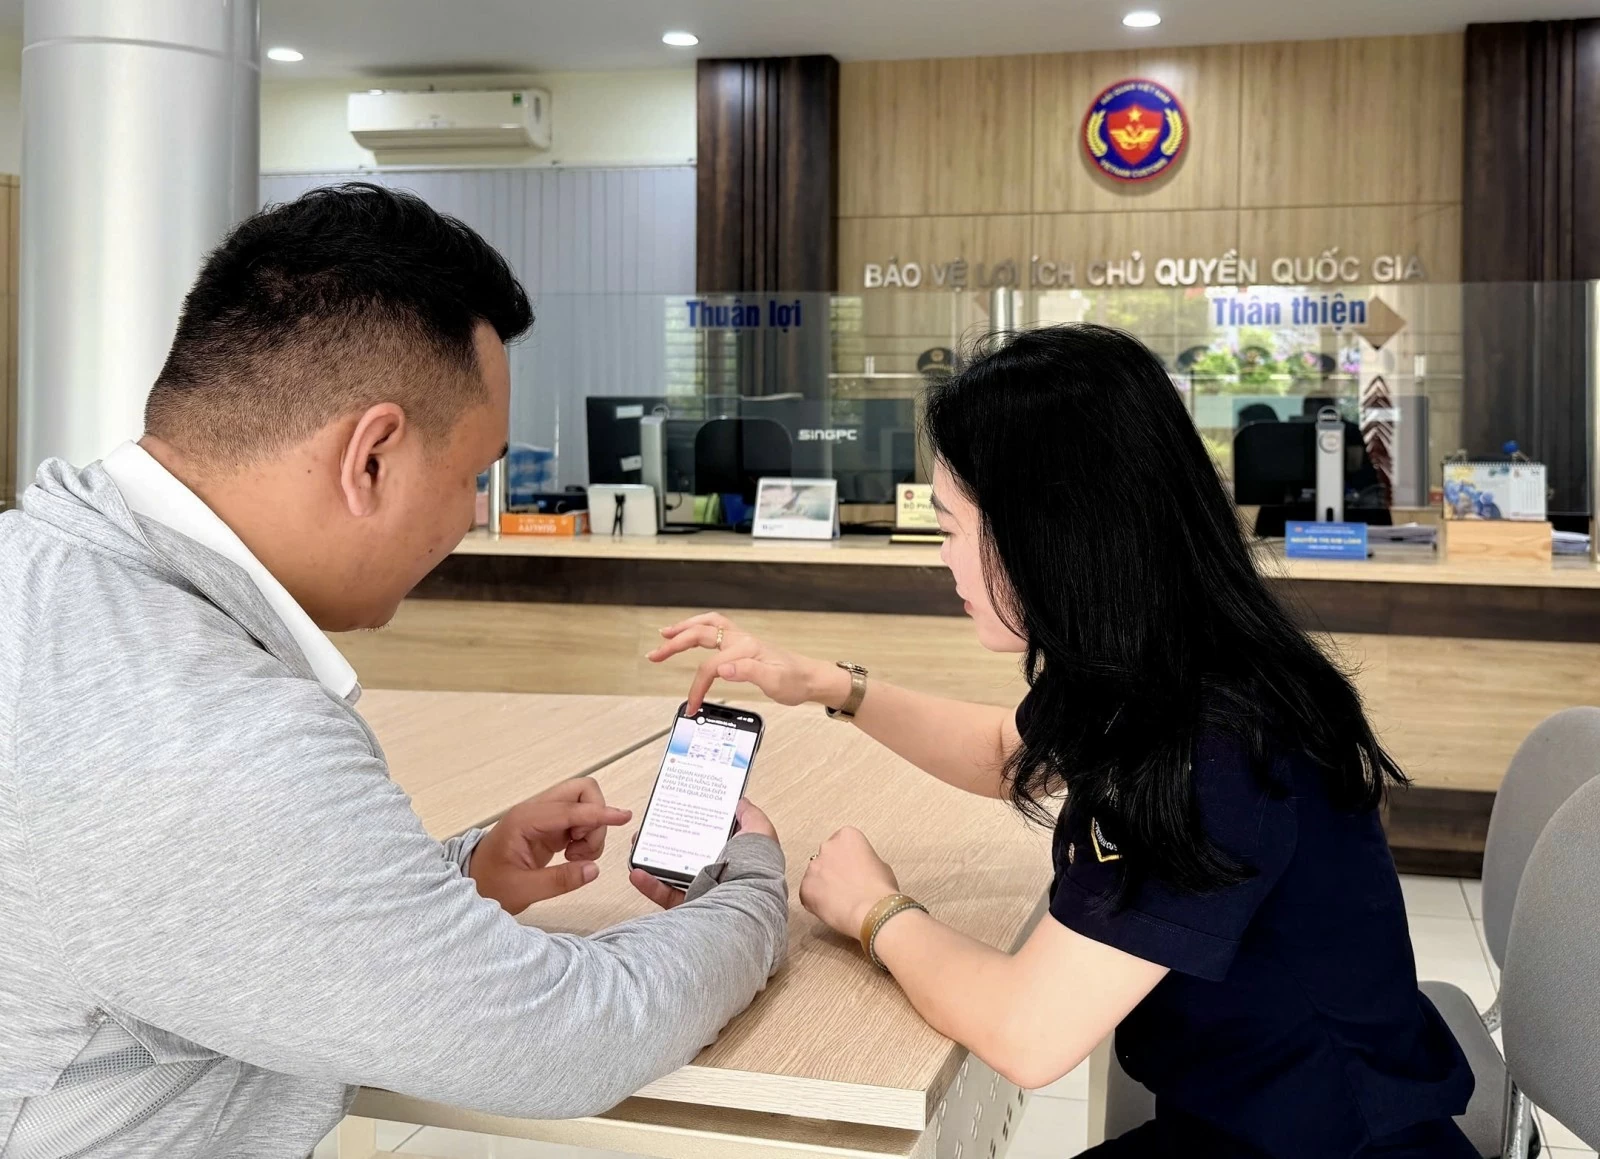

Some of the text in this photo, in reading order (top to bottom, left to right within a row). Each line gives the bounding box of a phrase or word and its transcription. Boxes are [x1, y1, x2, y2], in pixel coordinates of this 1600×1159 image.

[864, 255, 922, 288] BẢO
[1031, 254, 1076, 287] ÍCH
[1086, 249, 1146, 287] CHỦ
[1154, 247, 1258, 287] QUYỀN
[1271, 246, 1361, 285] QUỐC
[1371, 254, 1425, 284] GIA
[686, 299, 802, 333] Thuận lợi
[1212, 292, 1367, 332] Thân thiện
